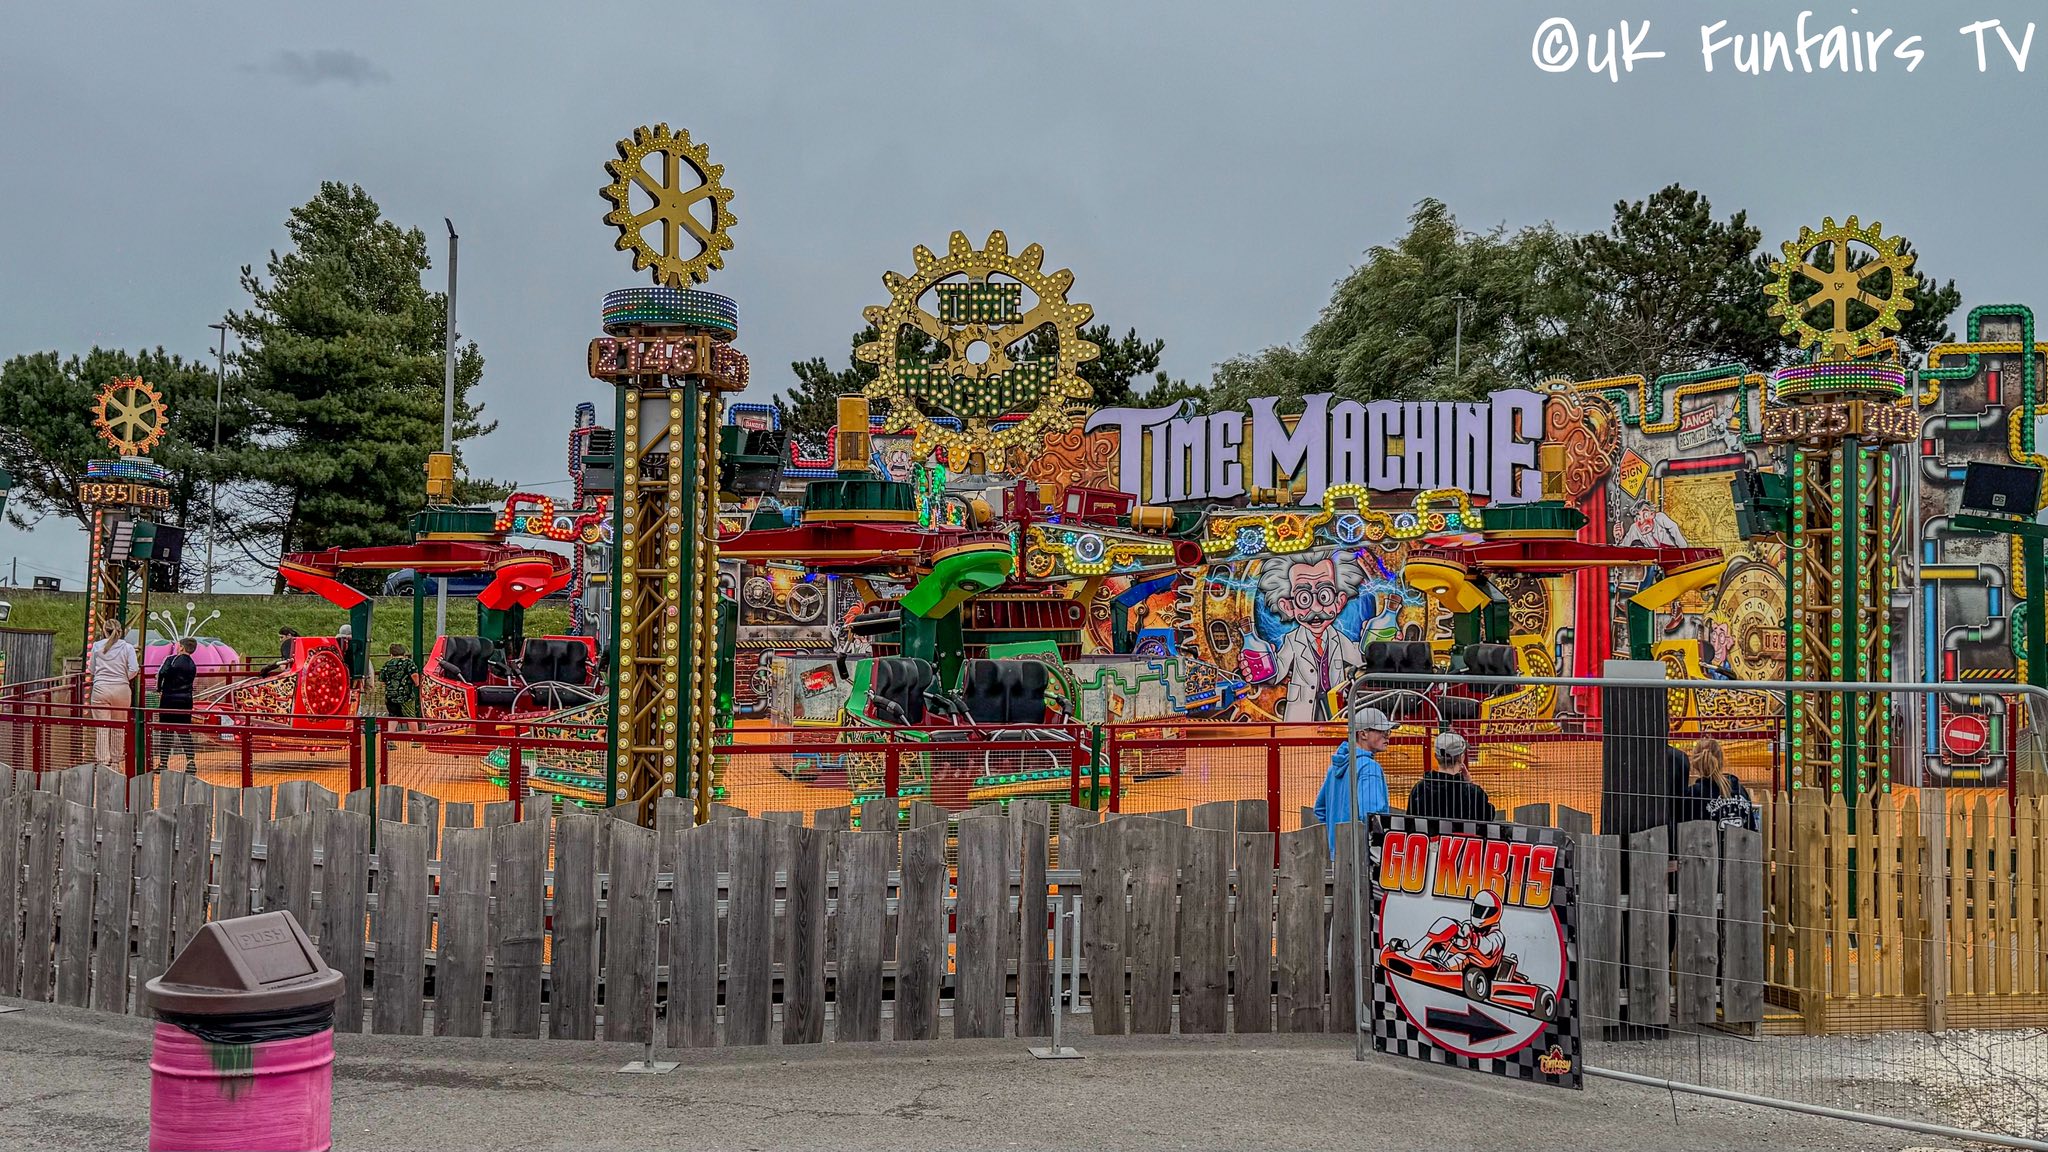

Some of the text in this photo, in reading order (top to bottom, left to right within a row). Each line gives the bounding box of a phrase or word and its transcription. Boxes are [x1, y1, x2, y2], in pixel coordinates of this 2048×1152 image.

[935, 282, 1023, 323] TIME
[598, 336, 697, 373] 2146
[896, 353, 1059, 417] MACHINE
[1764, 402, 1848, 439] 2025
[1866, 402, 1921, 438] 2020
[1621, 465, 1643, 480] SIGN
[80, 484, 129, 502] 1995
[1379, 831, 1558, 908] GO KARTS
[240, 928, 282, 945] PUSH
